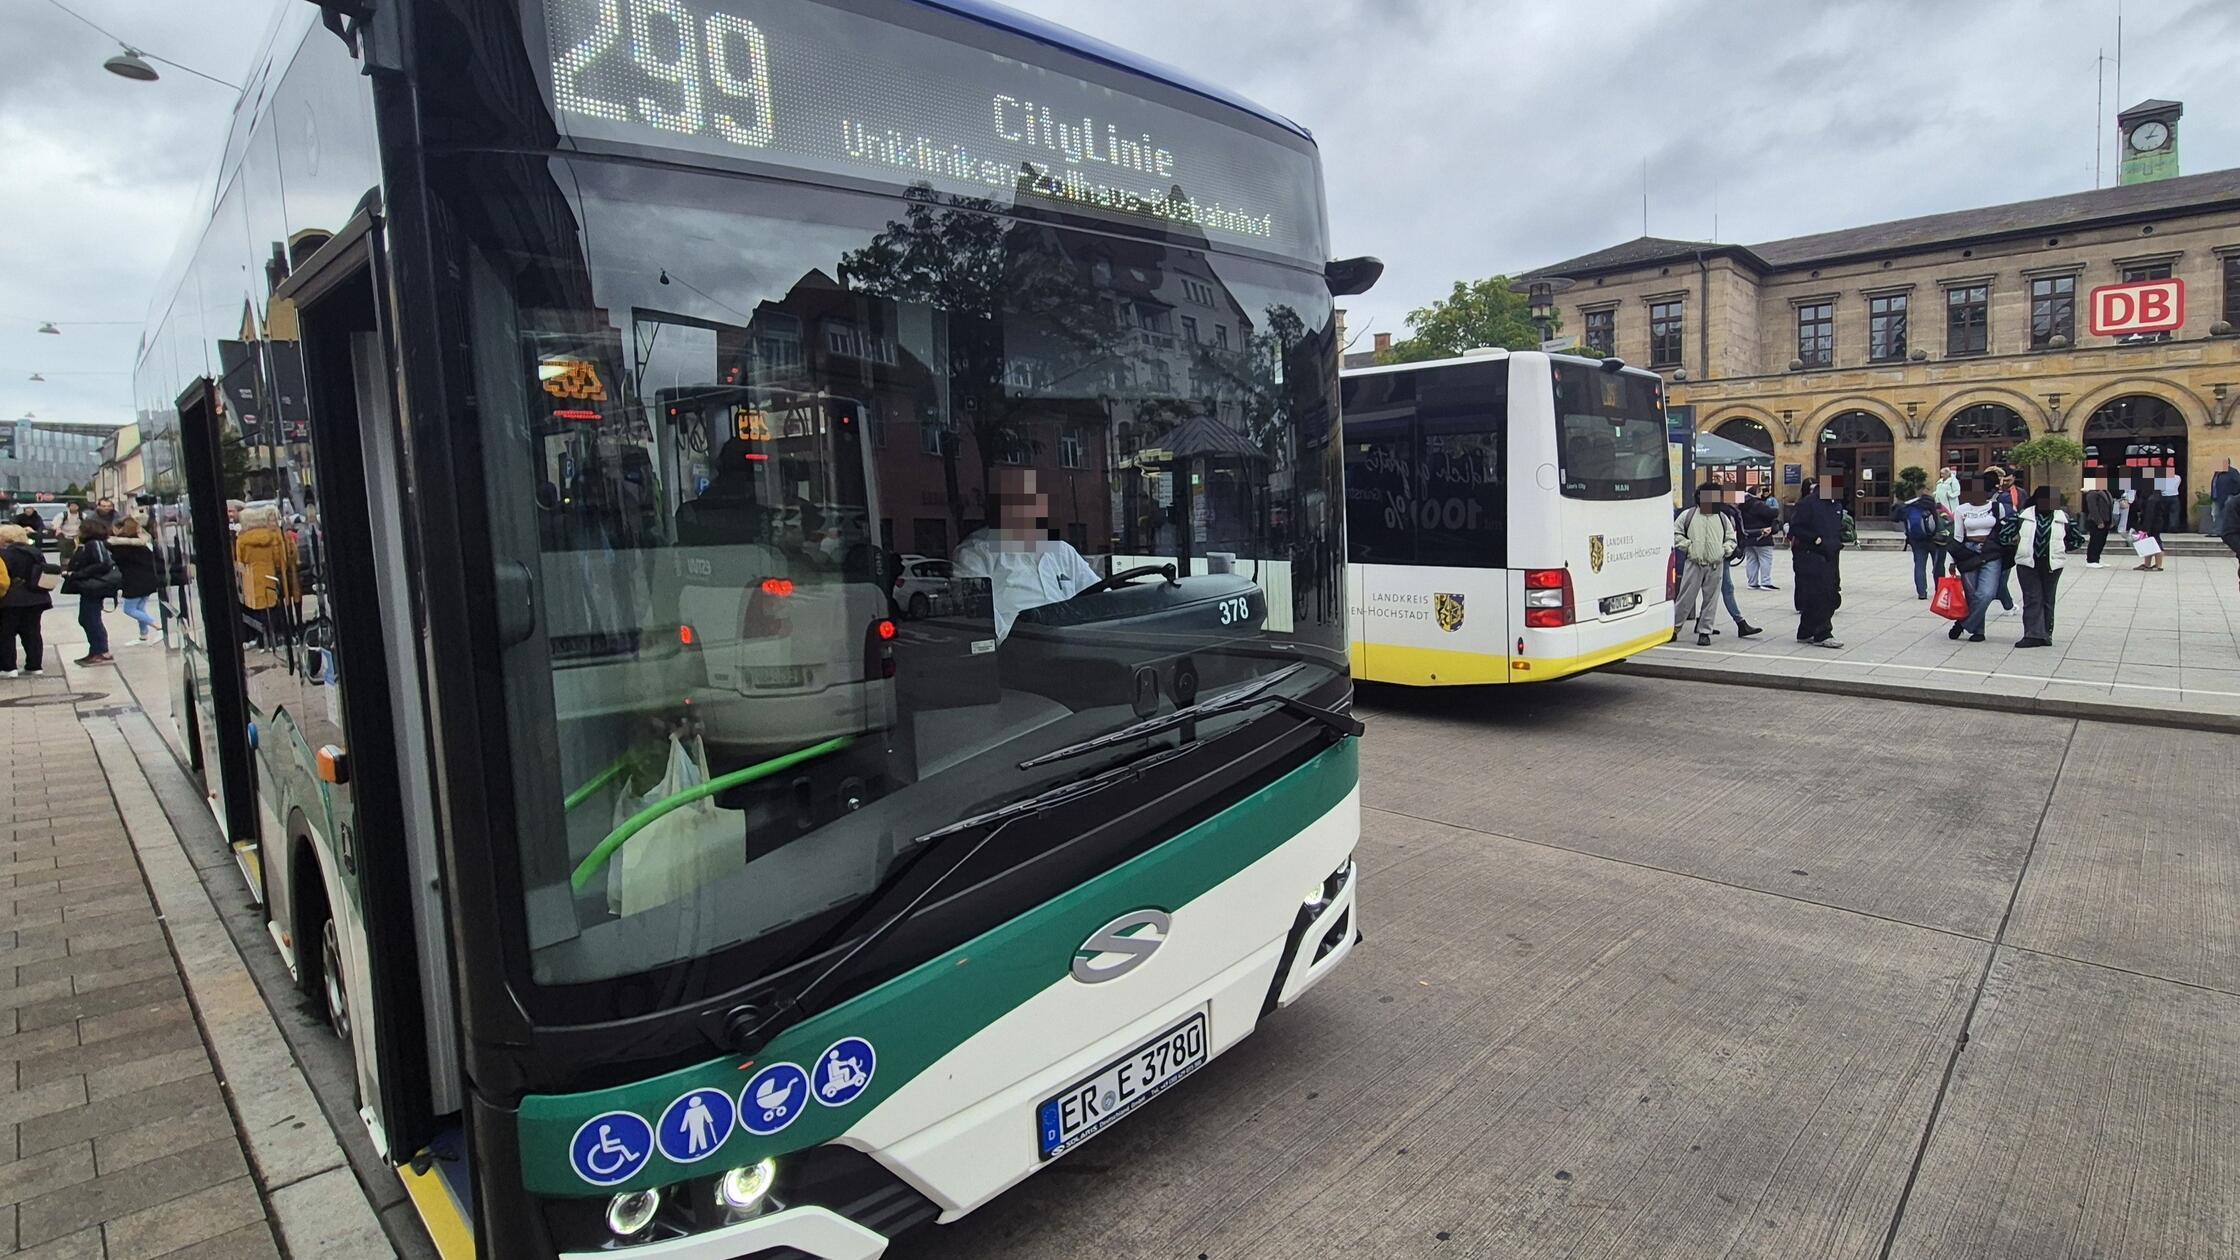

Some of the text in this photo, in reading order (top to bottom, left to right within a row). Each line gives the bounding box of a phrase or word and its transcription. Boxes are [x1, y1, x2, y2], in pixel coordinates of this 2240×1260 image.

[552, 0, 774, 149] 299
[992, 93, 1175, 178] CityLinie
[2102, 288, 2171, 327] DB
[1614, 483, 1630, 492] MAN
[1219, 596, 1249, 625] 378
[1372, 592, 1429, 605] LANDKREIS
[1061, 1084, 1100, 1136] ER
[1117, 1063, 1136, 1102] E
[1141, 1023, 1201, 1087] 3780
[1048, 1129, 1056, 1141] D
[1065, 1124, 1098, 1148] SOLARIS
